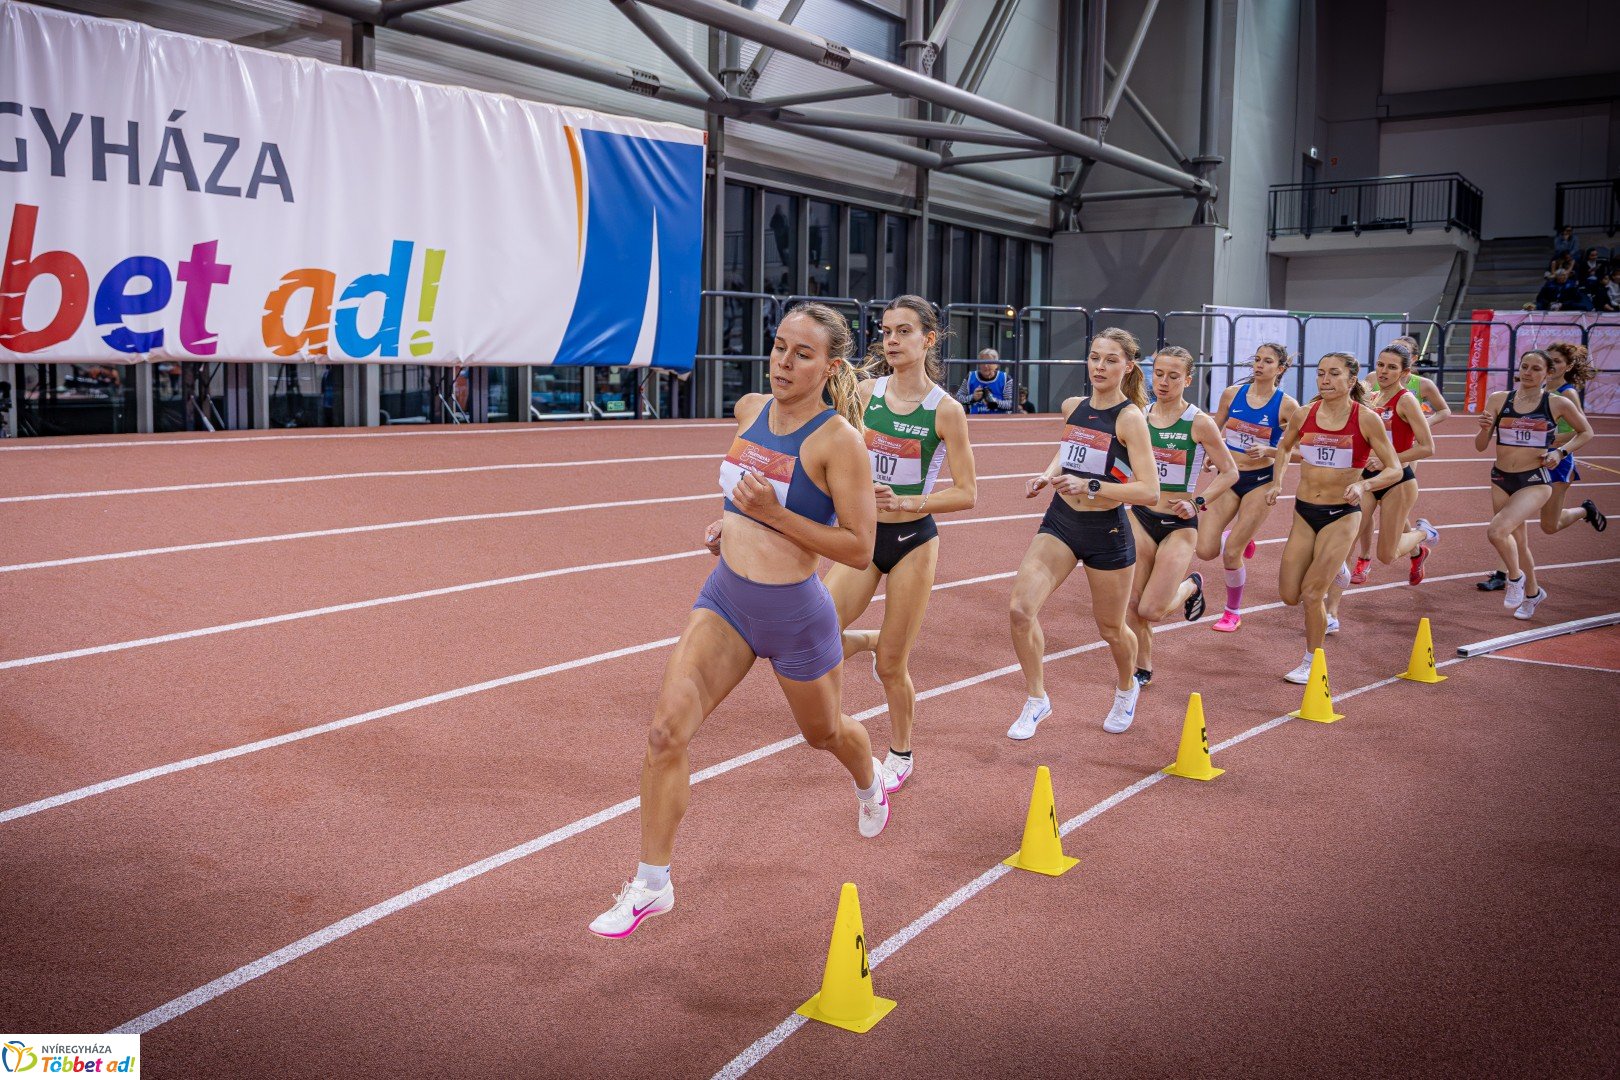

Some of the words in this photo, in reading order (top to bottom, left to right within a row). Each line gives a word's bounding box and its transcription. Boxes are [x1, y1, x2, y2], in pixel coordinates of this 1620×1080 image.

[261, 239, 446, 357] ad!
[1515, 430, 1531, 441] 110
[1067, 444, 1087, 463] 119
[1317, 447, 1335, 461] 157
[875, 454, 897, 475] 107
